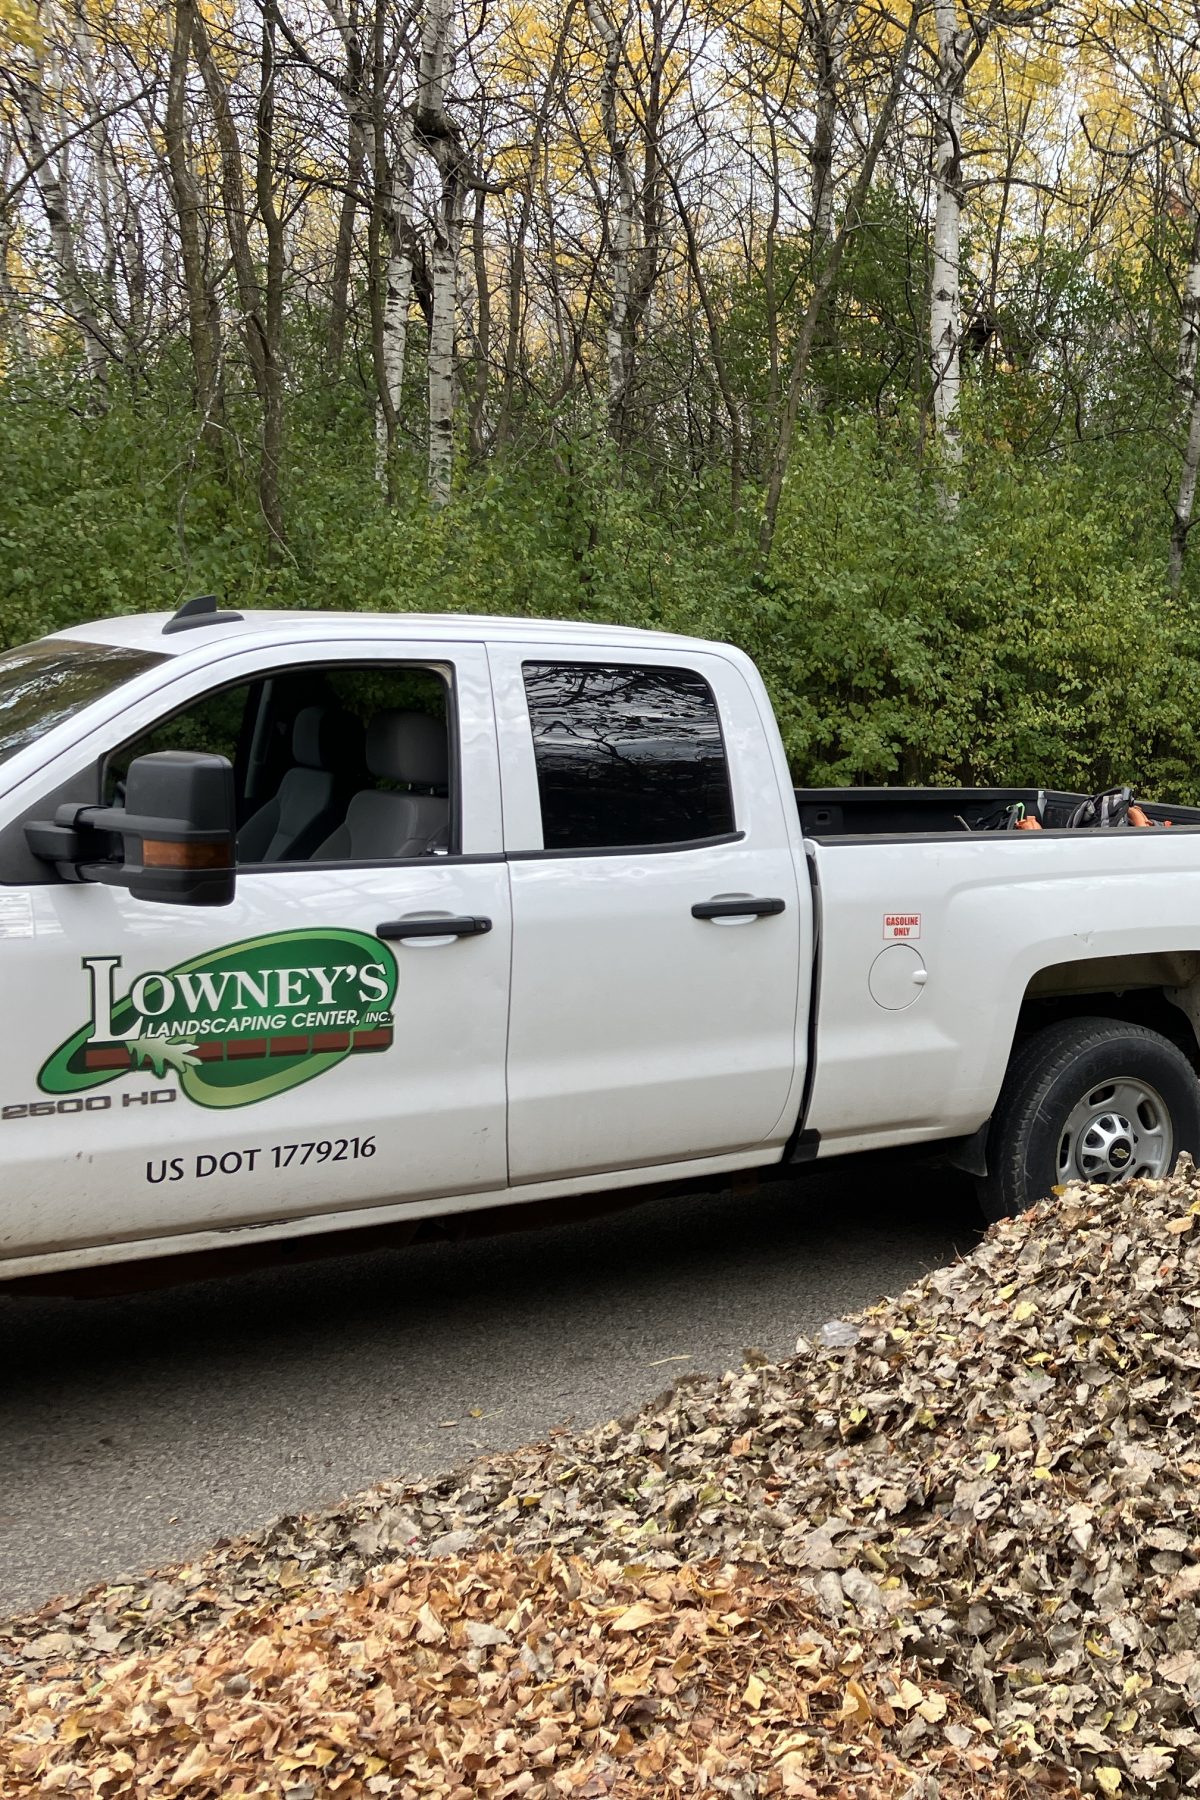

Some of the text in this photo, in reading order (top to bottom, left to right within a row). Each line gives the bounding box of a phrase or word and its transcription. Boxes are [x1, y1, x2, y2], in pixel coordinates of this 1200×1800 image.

[886, 916, 919, 926] GASOLINE
[894, 927, 910, 936] ONLY
[85, 961, 390, 1043] LOWNEY'S
[146, 1009, 391, 1039] LANDSCAPING CENTER, INC.
[1, 1088, 177, 1120] 2500 HD
[146, 1135, 377, 1184] US DOT 1779216
